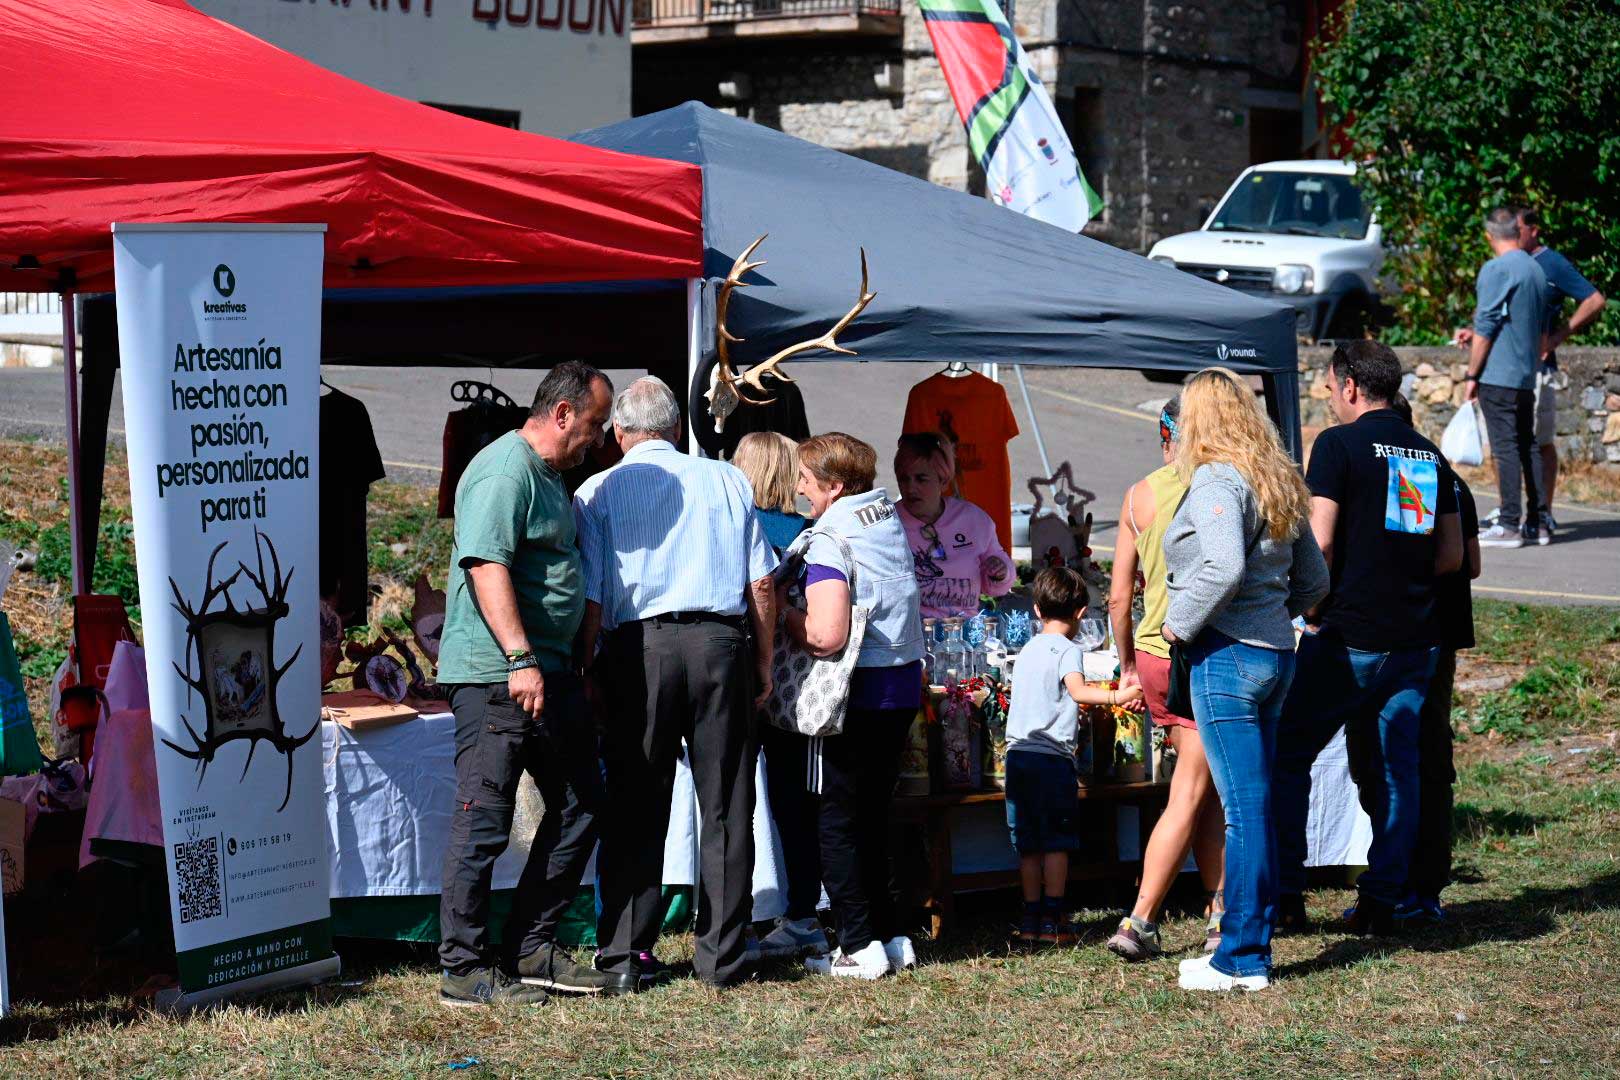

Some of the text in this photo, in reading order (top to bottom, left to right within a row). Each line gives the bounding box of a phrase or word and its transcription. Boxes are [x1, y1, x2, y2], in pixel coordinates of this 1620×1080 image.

[203, 300, 247, 313] kreativas
[173, 337, 282, 372] Artesanía
[171, 379, 287, 410] hecha con
[190, 412, 269, 458] pasión,
[156, 449, 309, 498] personalizada
[200, 486, 266, 533] para ti
[208, 950, 310, 985] DEDICACIÓN Y DETALLE
[214, 936, 302, 967] HECHO A MANO CON
